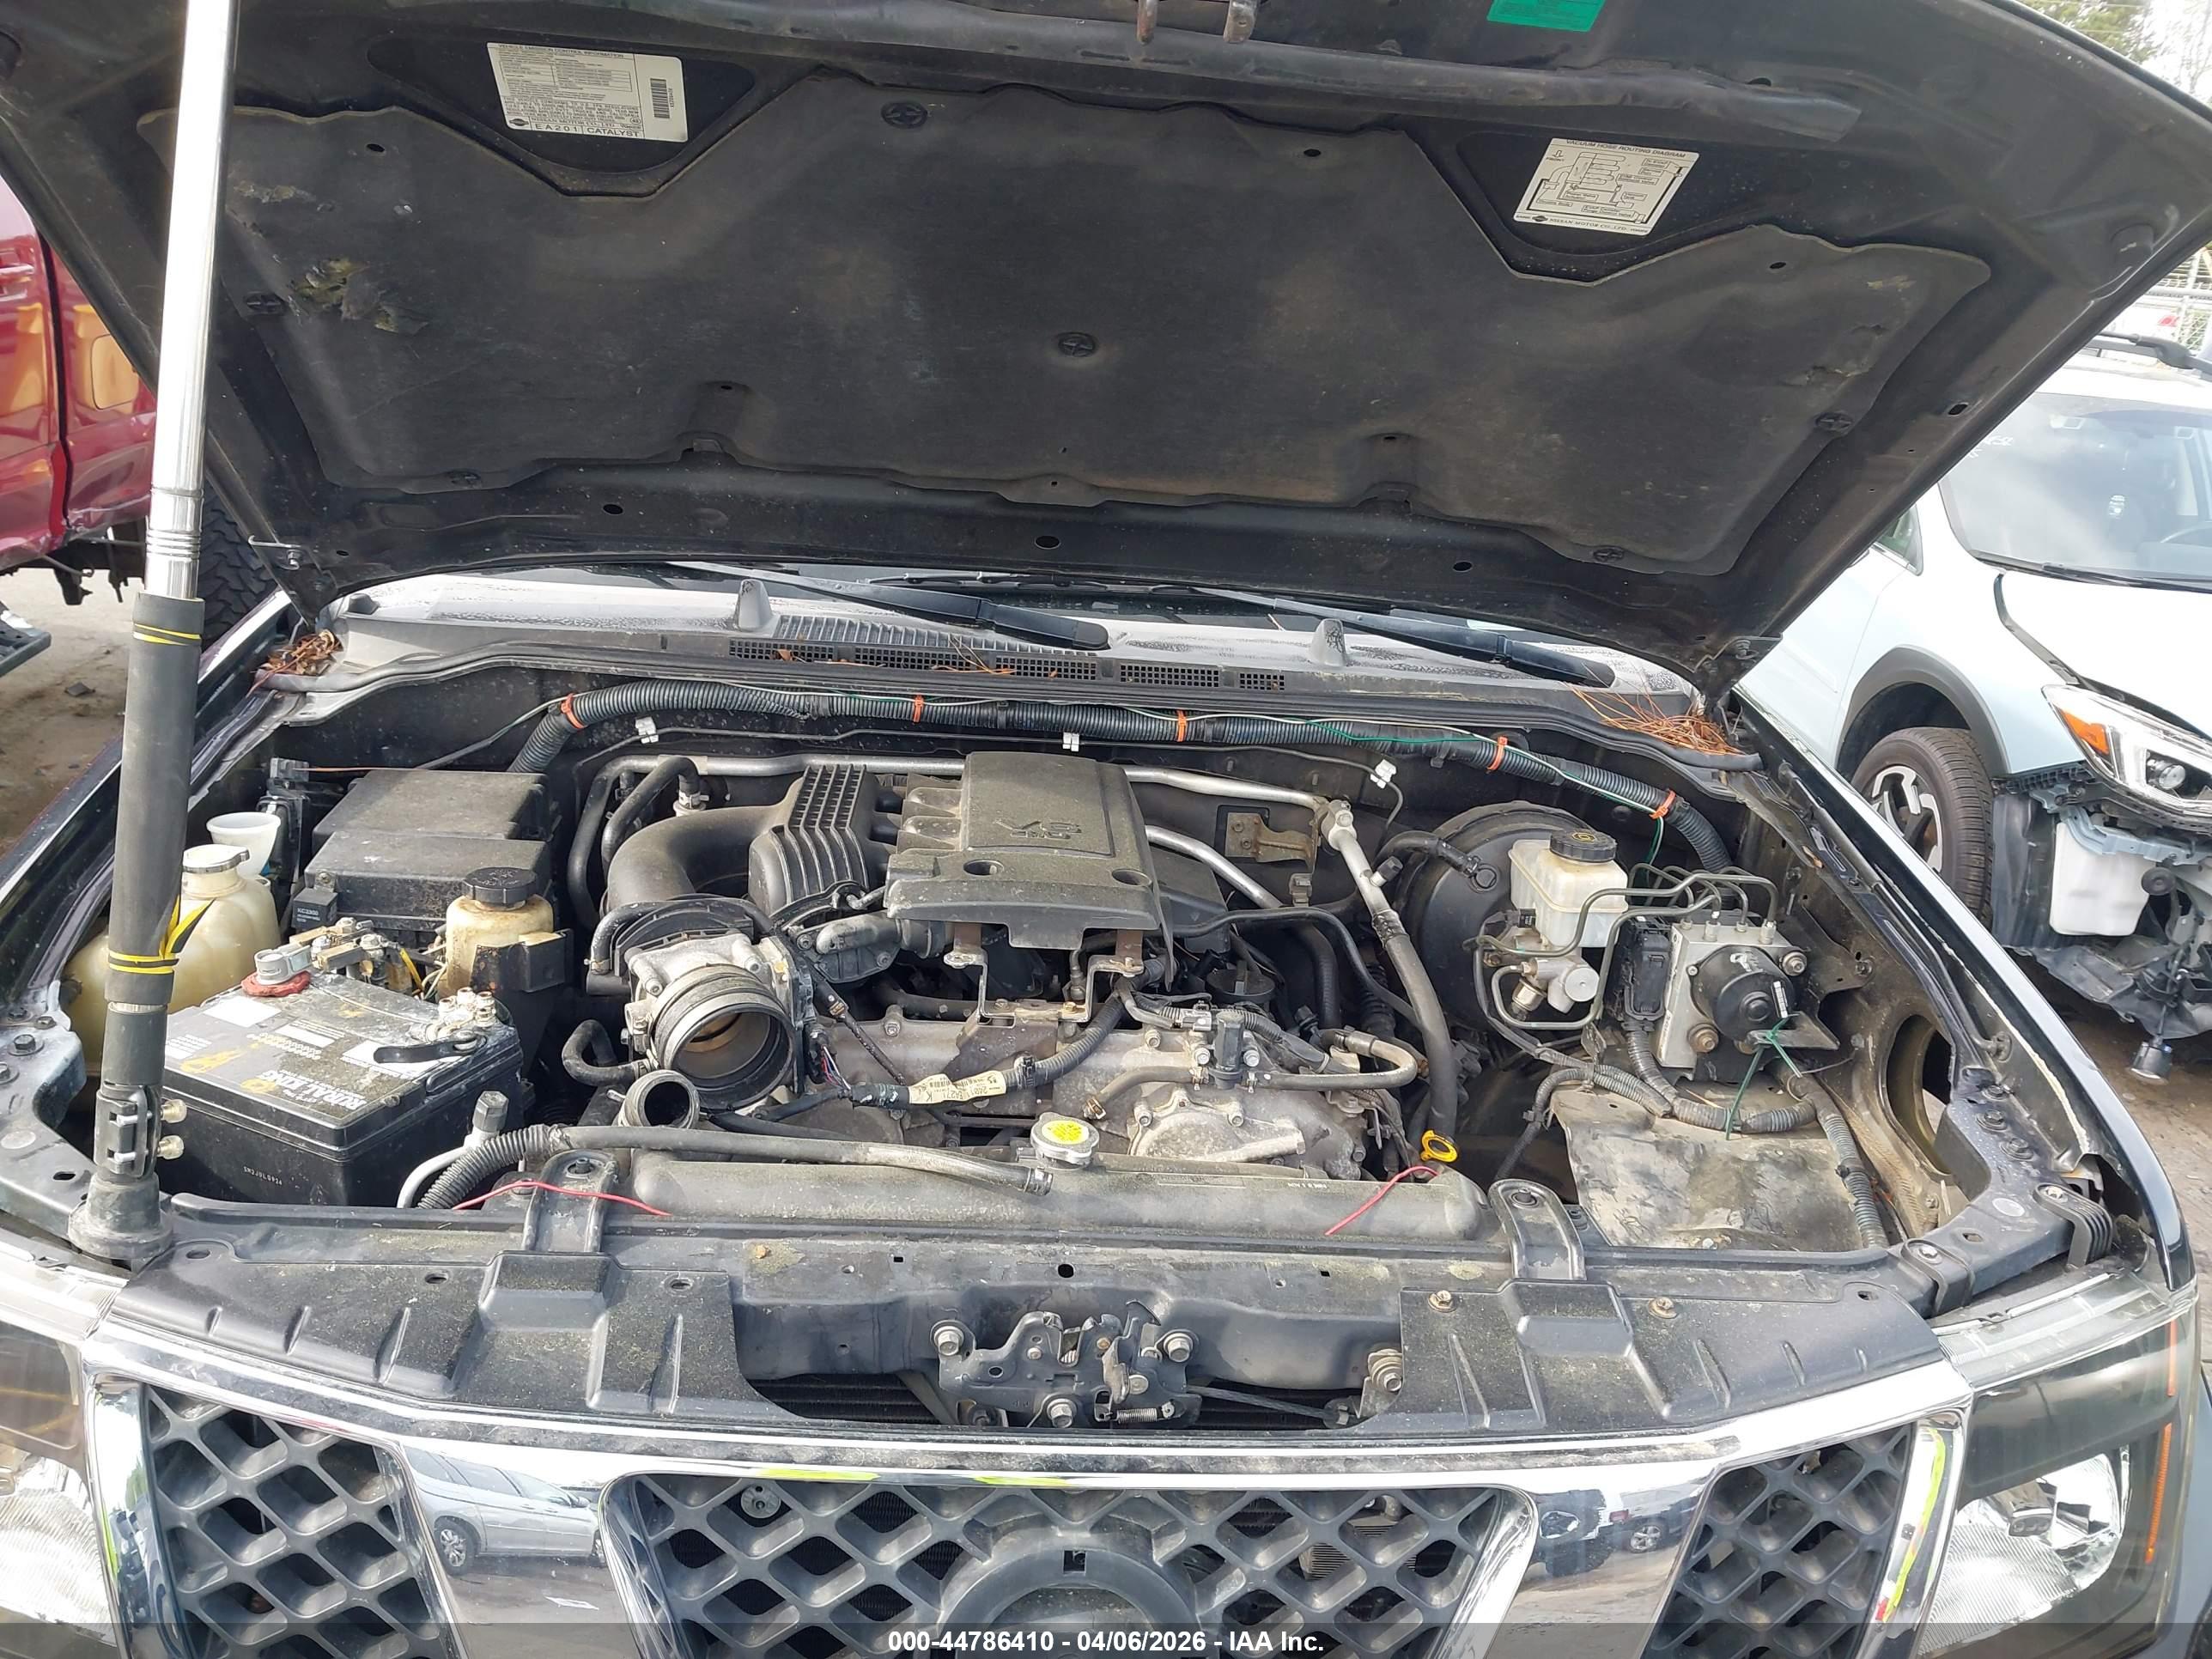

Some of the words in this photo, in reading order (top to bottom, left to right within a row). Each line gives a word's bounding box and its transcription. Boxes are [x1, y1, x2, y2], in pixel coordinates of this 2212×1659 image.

[534, 123, 577, 131] EA201
[586, 127, 639, 137] CATALYST
[256, 1070, 307, 1095] KING
[306, 1084, 367, 1110] RURAL
